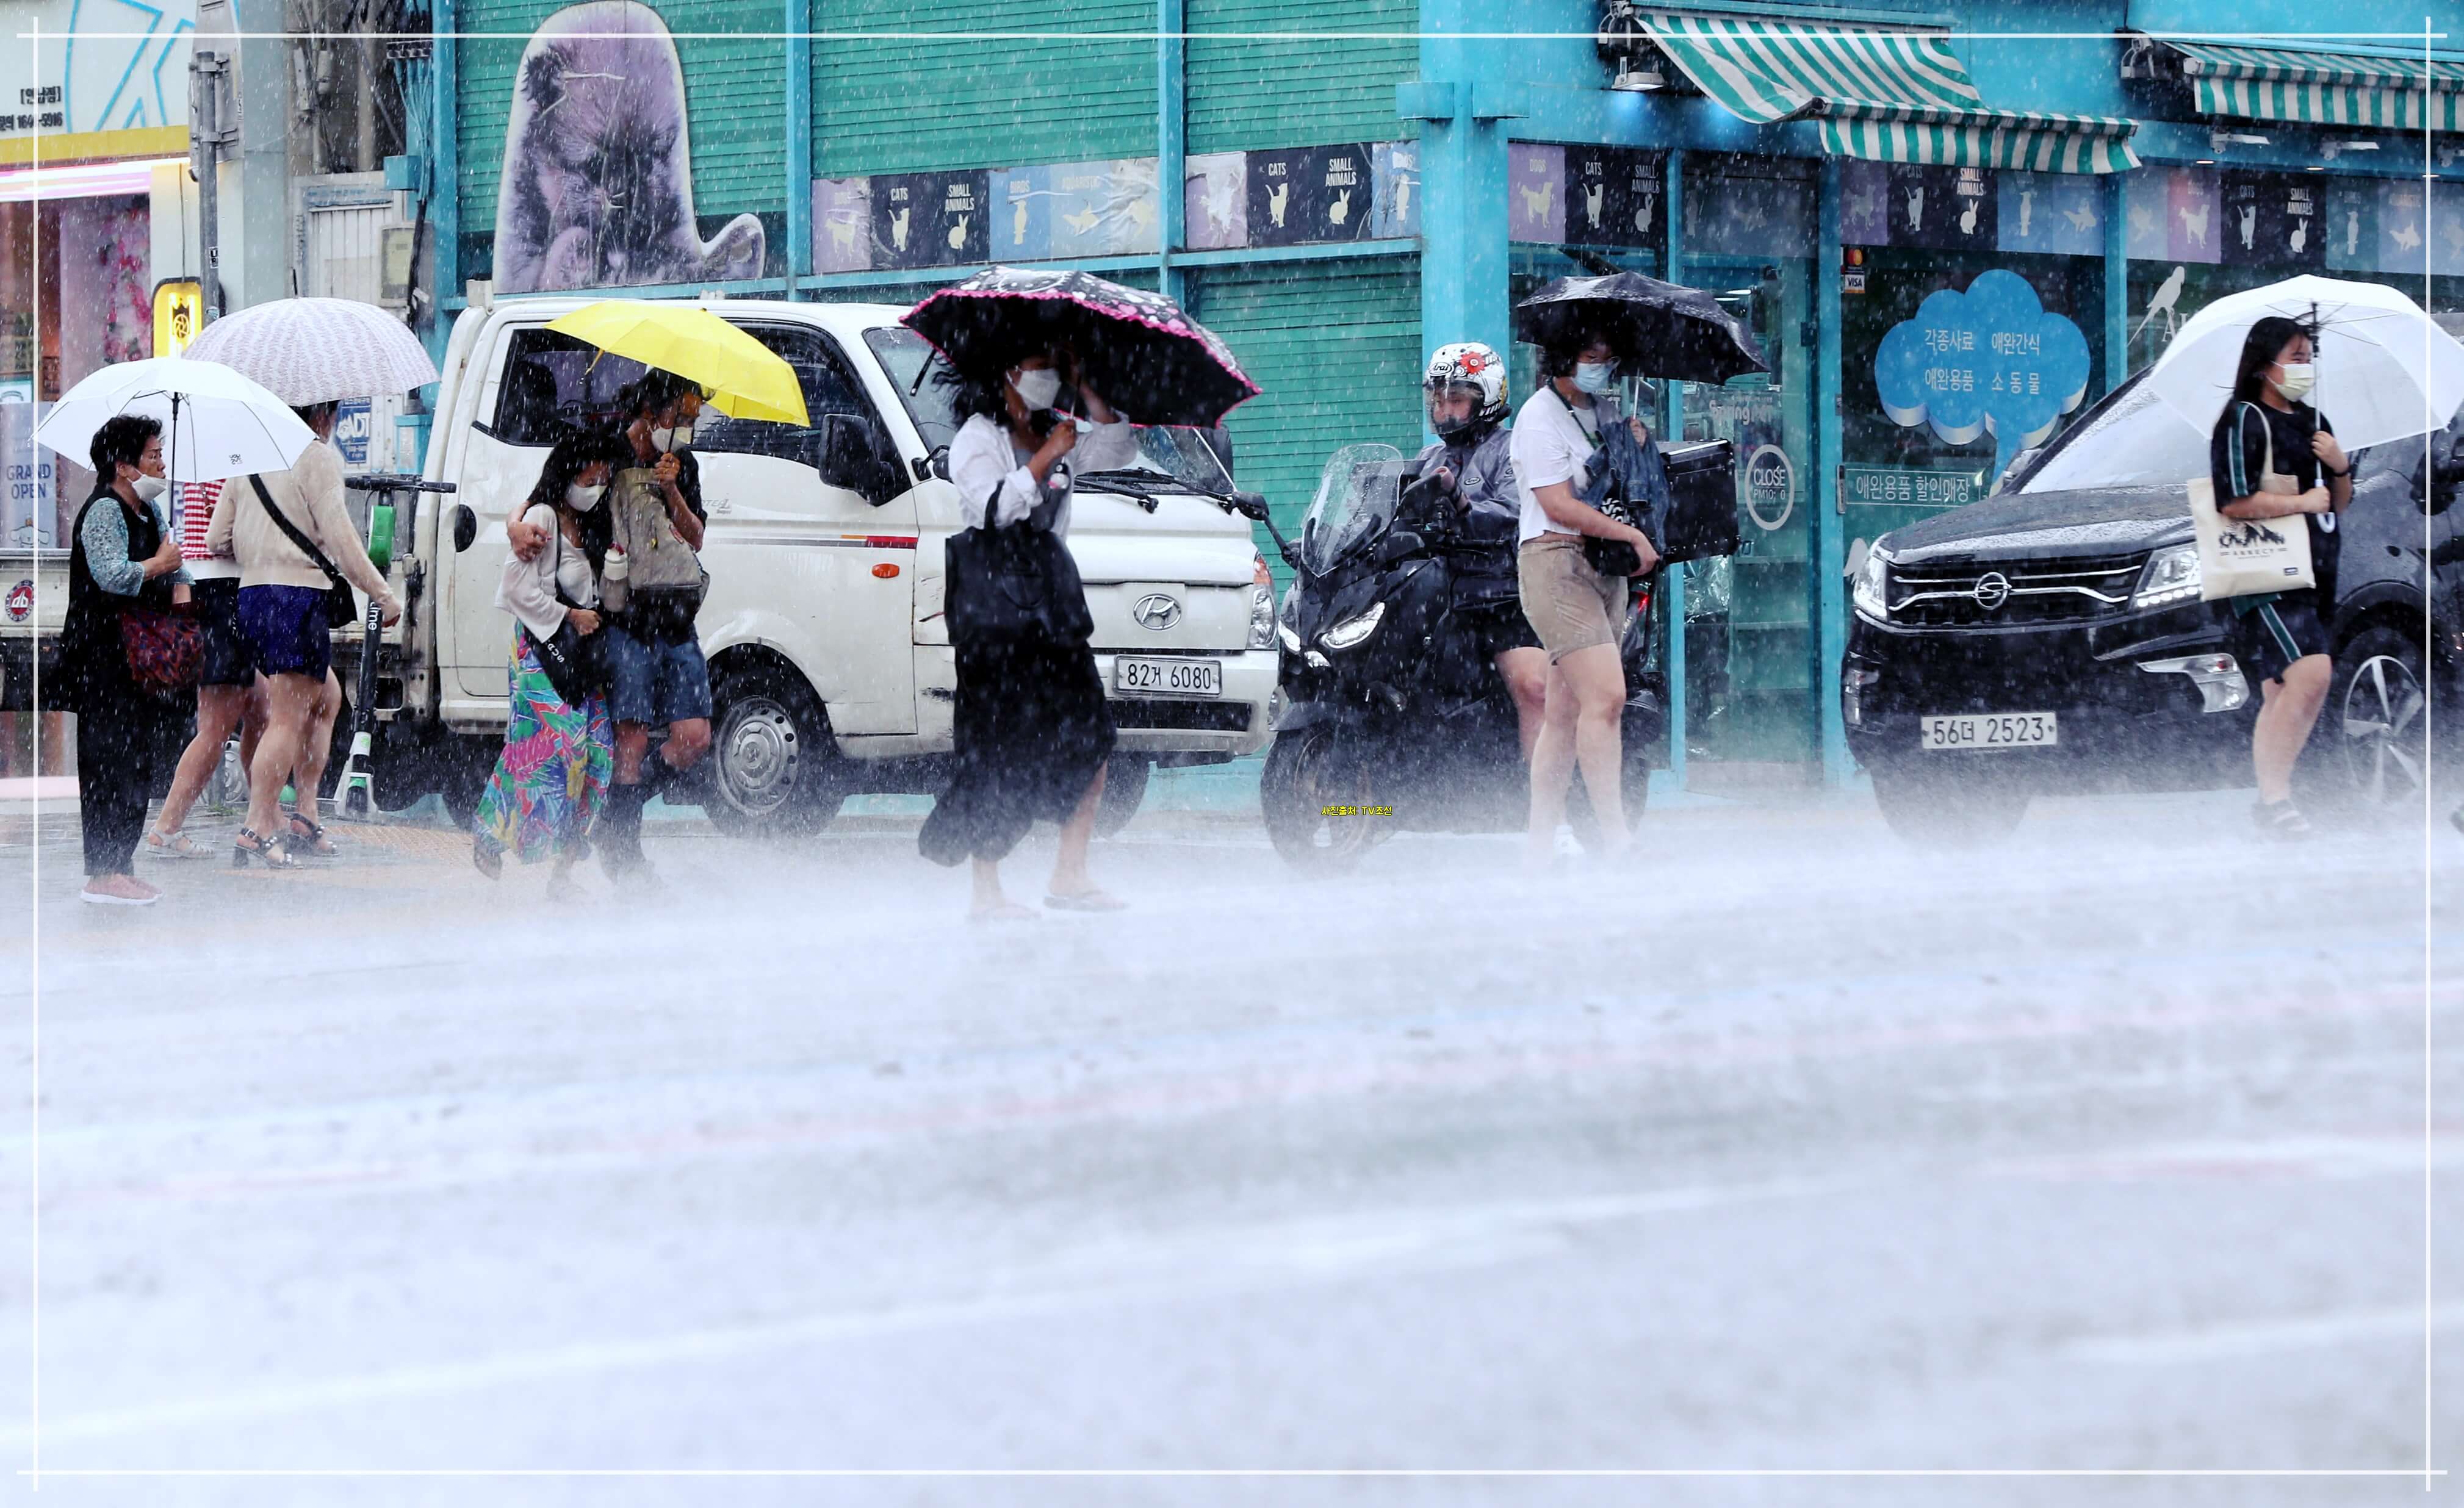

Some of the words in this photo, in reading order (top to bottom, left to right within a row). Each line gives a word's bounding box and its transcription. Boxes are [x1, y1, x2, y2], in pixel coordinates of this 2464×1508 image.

[1269, 163, 1287, 176] CATS
[1329, 157, 1352, 171] SMALL
[1529, 159, 1547, 173] DOGS
[1586, 162, 1602, 176] CATS
[1635, 165, 1657, 178] SMALL
[1960, 168, 1981, 181] SMALL
[1325, 172, 1356, 187] ANIMALS
[1632, 179, 1660, 194] ANIMALS
[891, 188, 908, 201] CATS
[948, 184, 971, 197] SMALL
[1957, 182, 1984, 196] ANIMALS
[2239, 185, 2255, 198] CATS
[2291, 188, 2310, 201] SMALL
[945, 198, 974, 212] ANIMALS
[2287, 201, 2313, 215] ANIMALS
[1848, 278, 1862, 287] VISA
[1925, 329, 1975, 353] 각종사료
[1991, 331, 2040, 356] 애완간식
[1925, 368, 1975, 392] 애완용품
[7, 464, 51, 481] GRAND
[1754, 468, 1785, 486] CLOSE
[11, 483, 46, 499] OPEN
[1856, 475, 1911, 500] 애완용품
[1915, 476, 1970, 503] 할인매장
[1128, 664, 1161, 686] 82거
[1170, 666, 1211, 690] 6080
[1934, 720, 1975, 745] 56더
[1987, 716, 2044, 743] 2523
